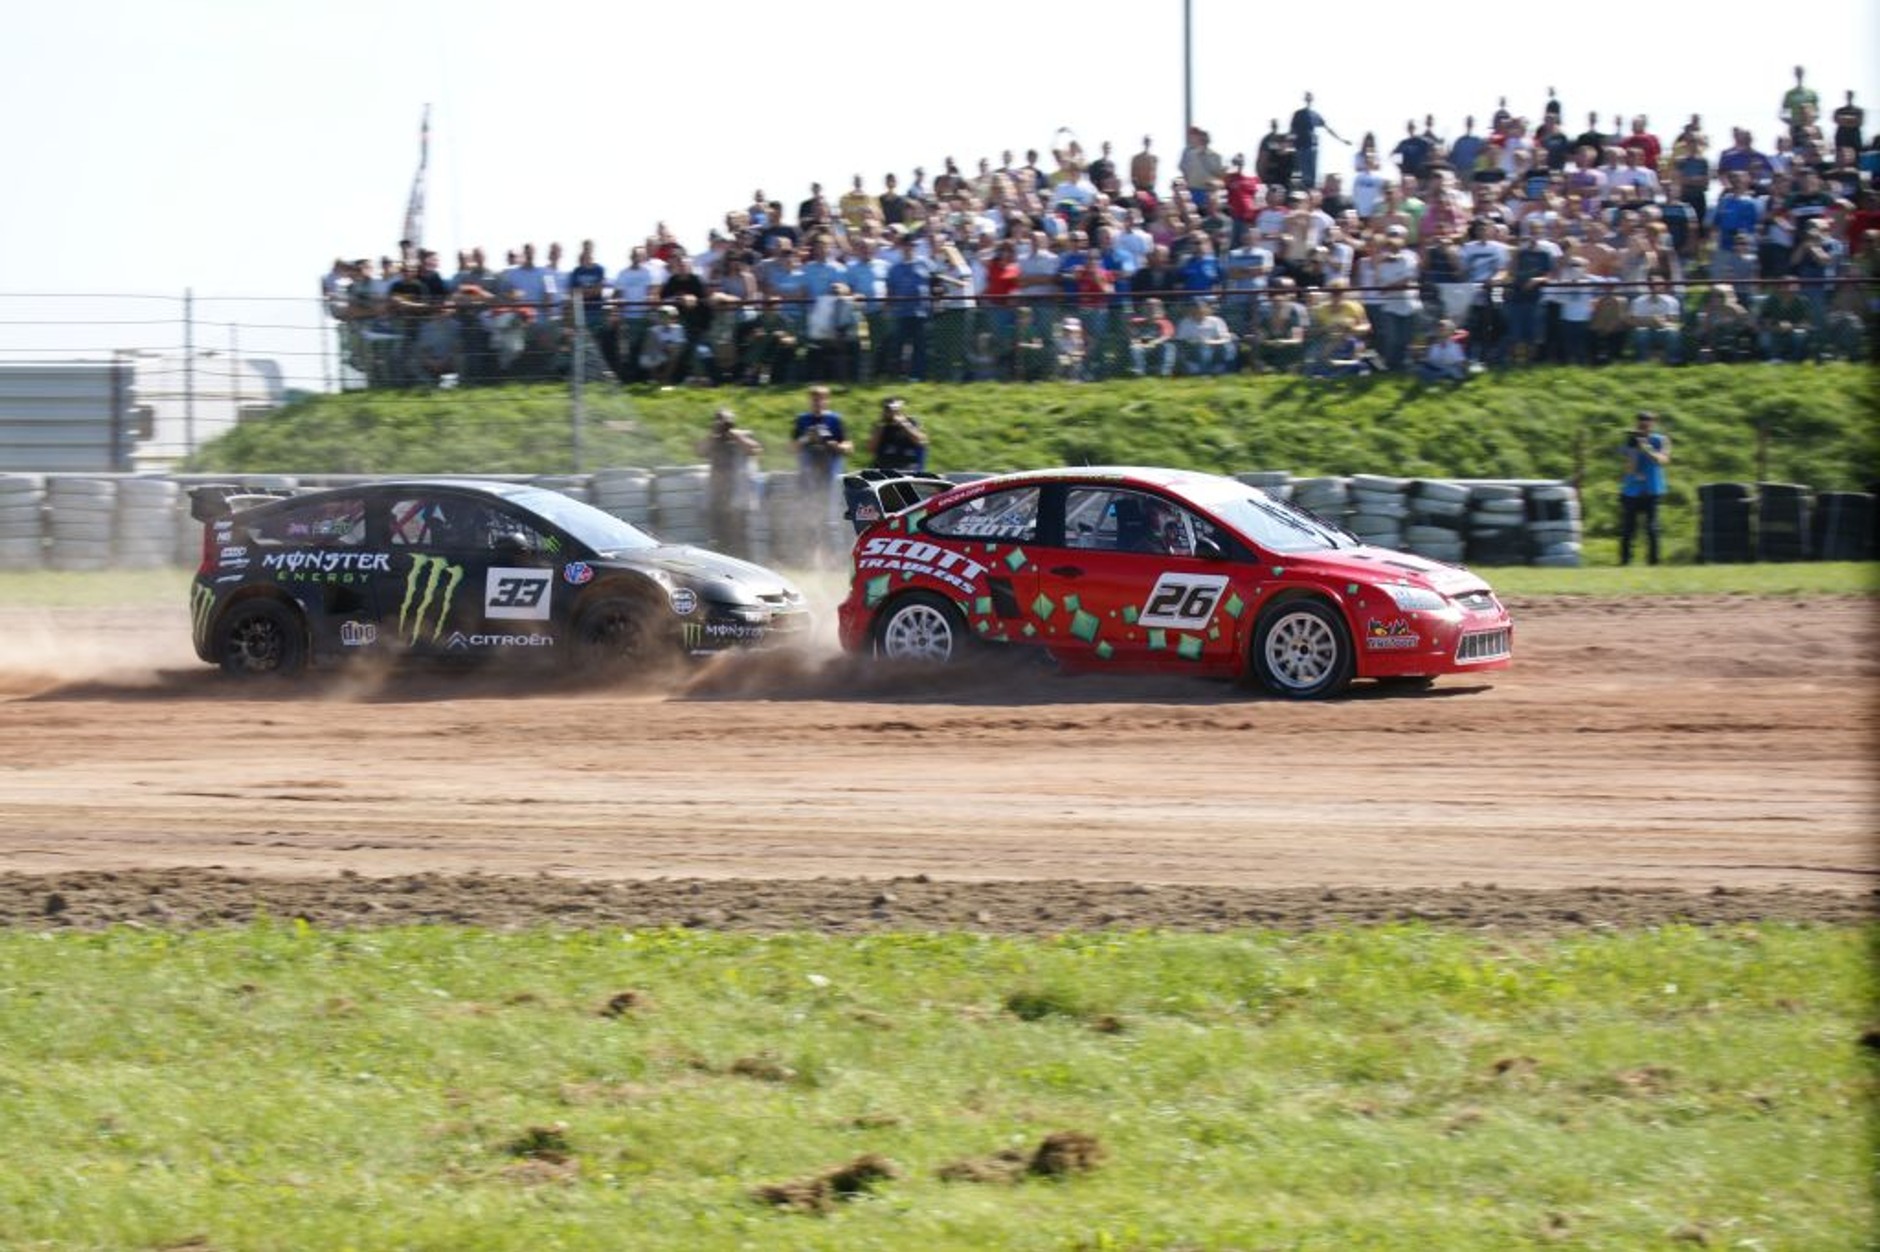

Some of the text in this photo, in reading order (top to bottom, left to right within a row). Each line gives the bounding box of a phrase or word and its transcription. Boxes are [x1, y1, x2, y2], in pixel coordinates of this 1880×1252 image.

[262, 550, 392, 573] MONSTER
[861, 537, 989, 580] SCOTT
[276, 571, 370, 584] ENERGY
[488, 577, 548, 608] 33
[1147, 584, 1221, 618] 26
